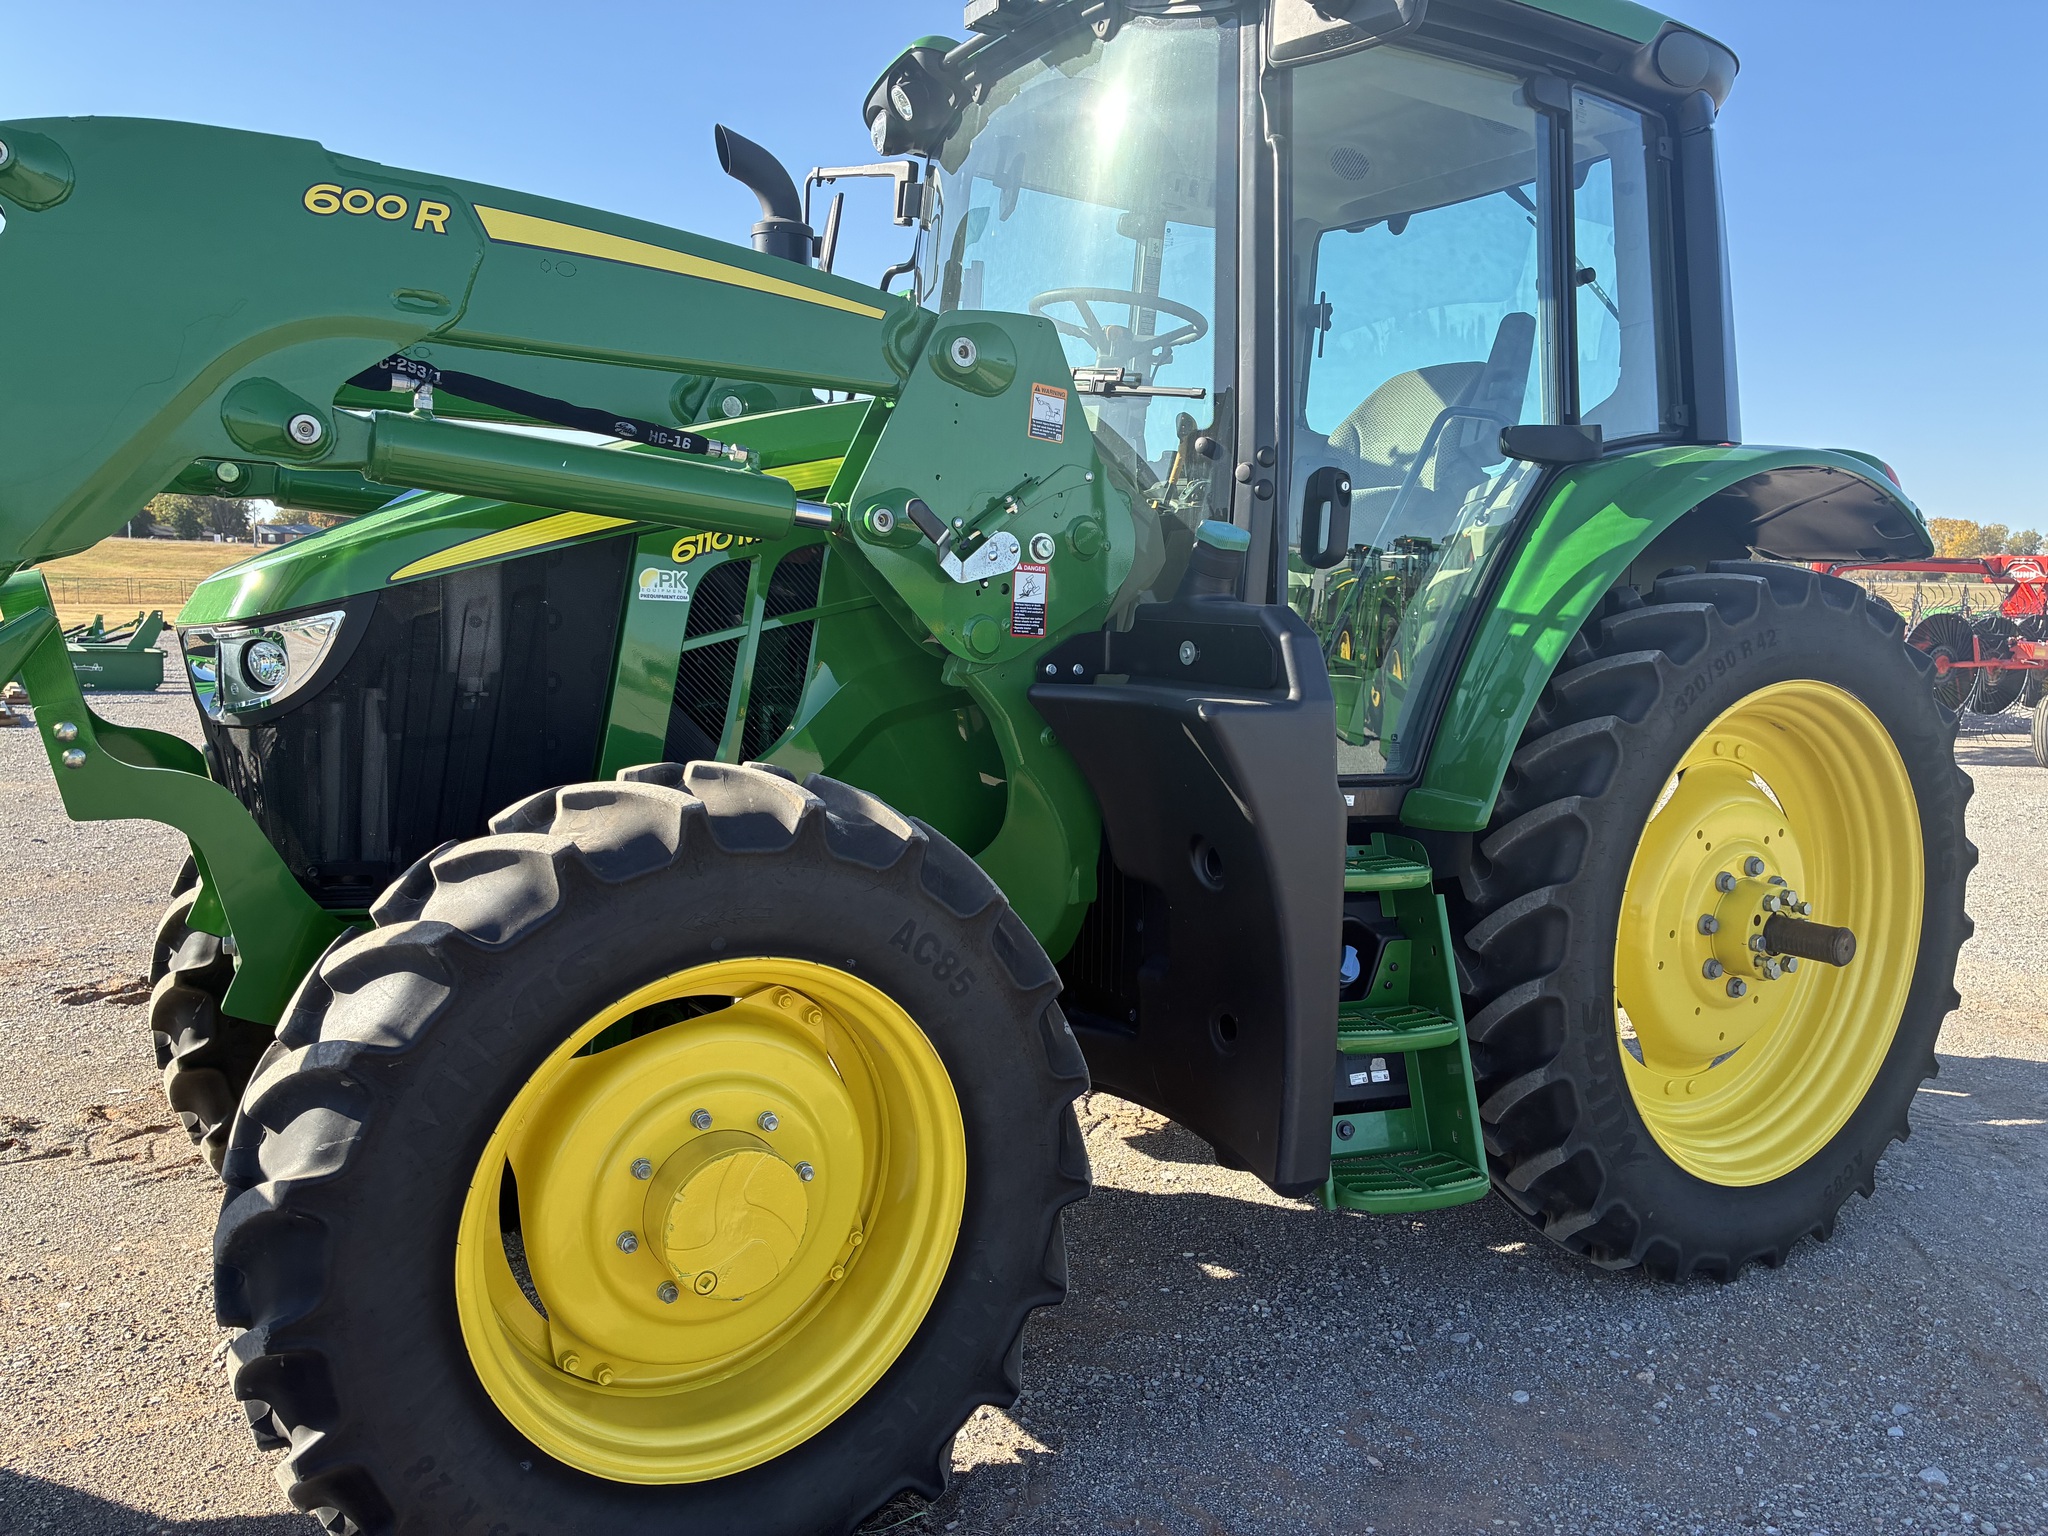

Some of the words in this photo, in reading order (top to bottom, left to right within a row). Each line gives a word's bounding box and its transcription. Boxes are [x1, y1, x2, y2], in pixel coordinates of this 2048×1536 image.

[303, 182, 409, 221] 600
[412, 198, 452, 235] R
[375, 357, 443, 386] C-293/1
[1041, 387, 1066, 398] WARNING
[648, 429, 692, 450] HG-16
[671, 531, 734, 564] 6110
[1023, 564, 1046, 572] DANGER
[640, 593, 689, 601] PKEQUIPMENT.COM
[1674, 648, 1737, 714] 320/90
[1756, 629, 1778, 651] 42
[887, 917, 979, 999] AC85
[1823, 1148, 1864, 1201] AC85
[402, 1454, 454, 1502] 28
